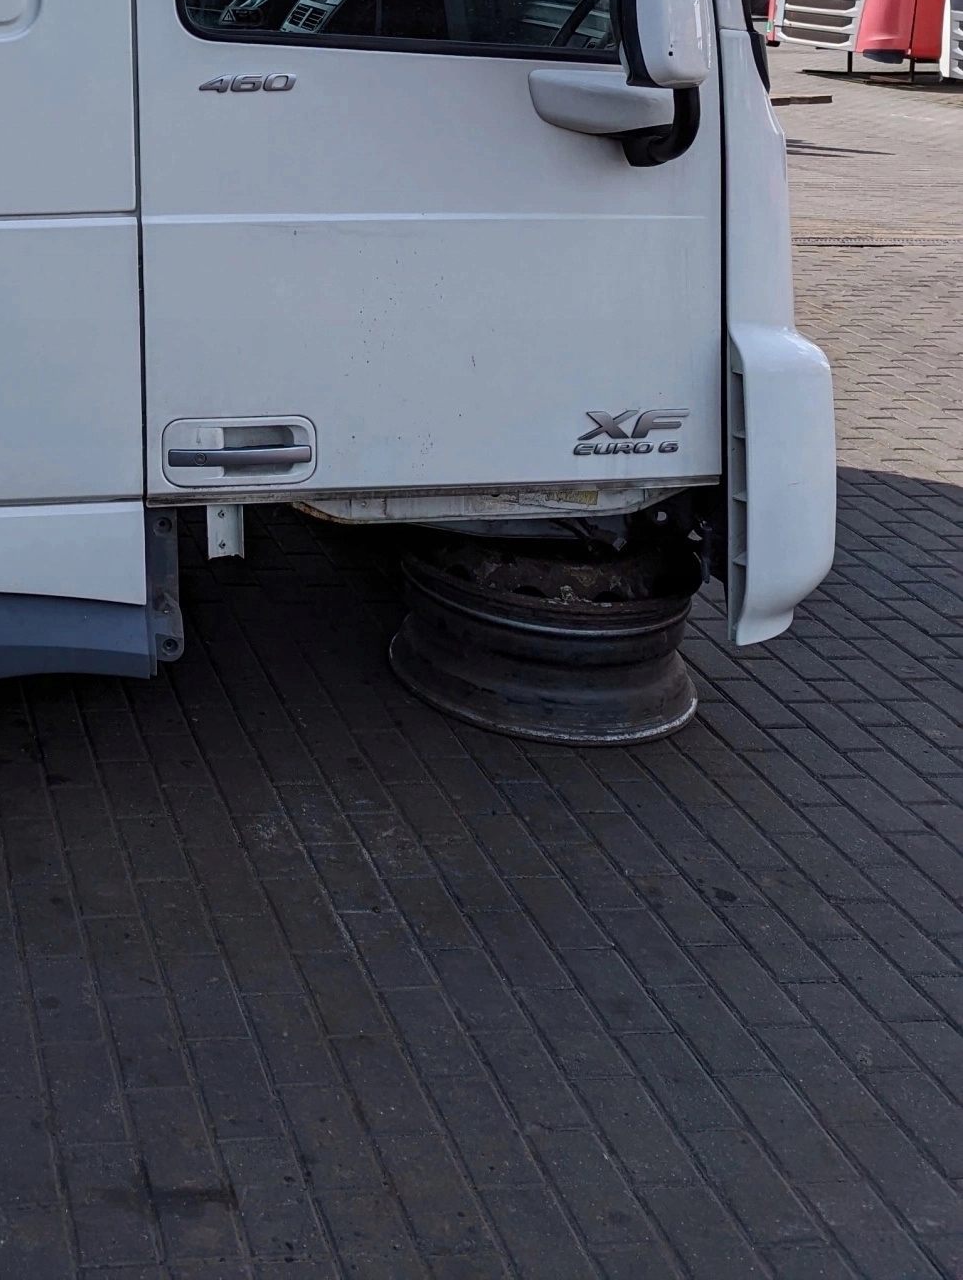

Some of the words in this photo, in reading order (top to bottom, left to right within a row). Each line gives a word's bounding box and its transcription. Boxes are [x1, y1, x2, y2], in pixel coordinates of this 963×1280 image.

[198, 73, 297, 93] 460
[577, 408, 689, 440] XF
[573, 442, 654, 455] EURO
[658, 441, 679, 453] 6
